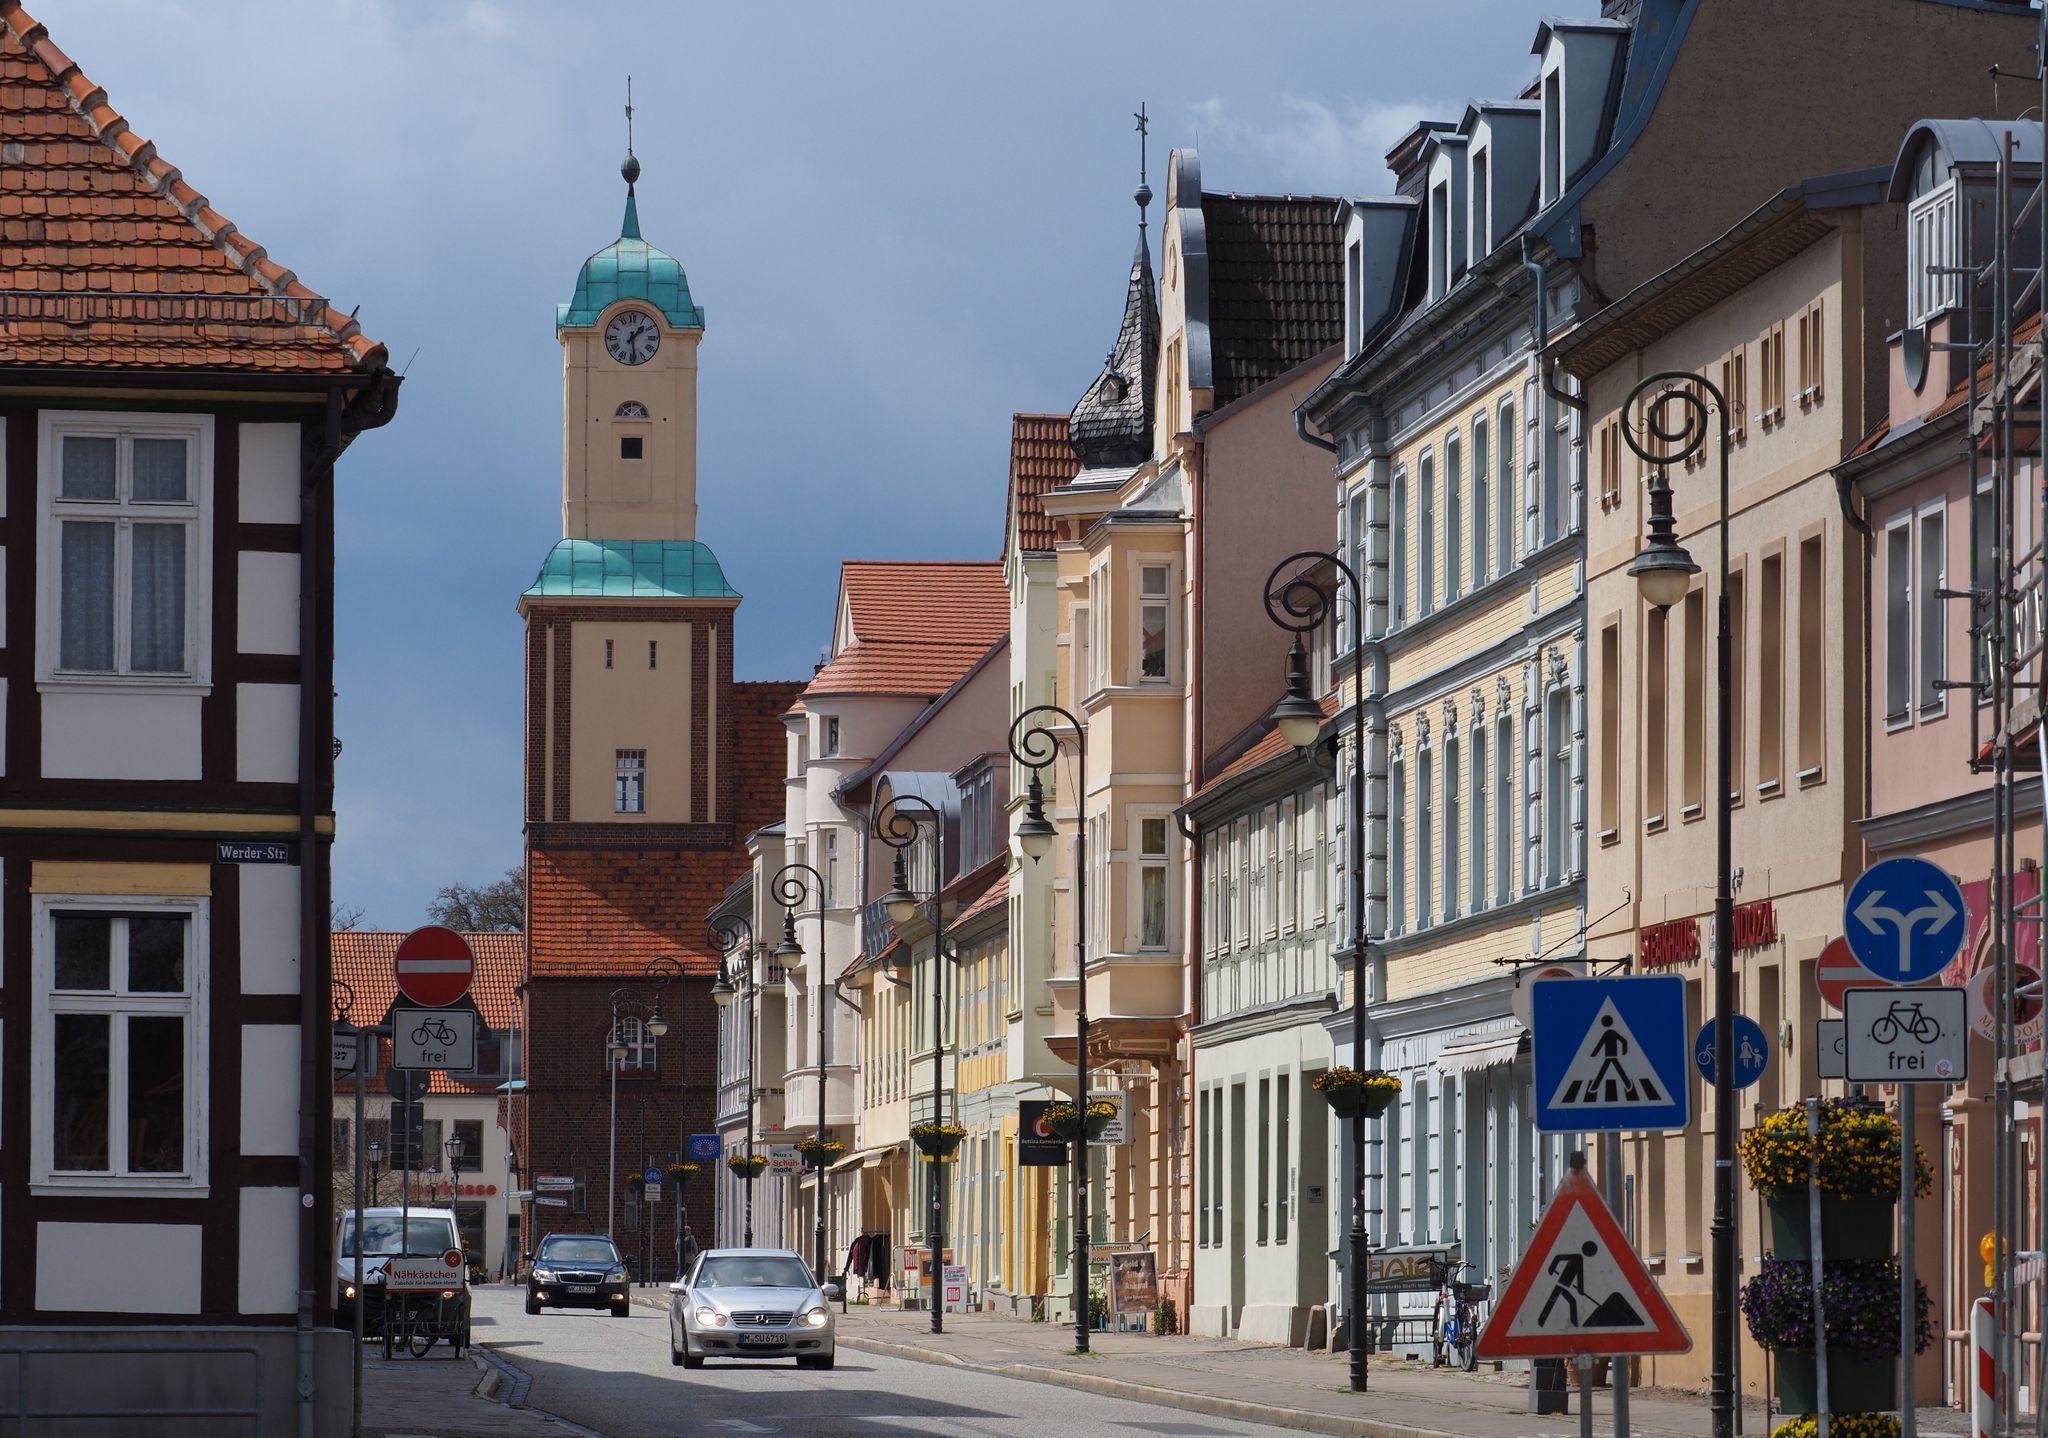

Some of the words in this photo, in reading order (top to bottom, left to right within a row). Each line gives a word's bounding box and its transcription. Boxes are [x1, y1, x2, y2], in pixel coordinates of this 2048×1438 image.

[1641, 918, 1698, 968] STEAKHAUS
[1733, 901, 1774, 951] NDOZA
[422, 1049, 447, 1063] frei
[1888, 1050, 1925, 1070] frei
[393, 1269, 457, 1279] Nähkästchen
